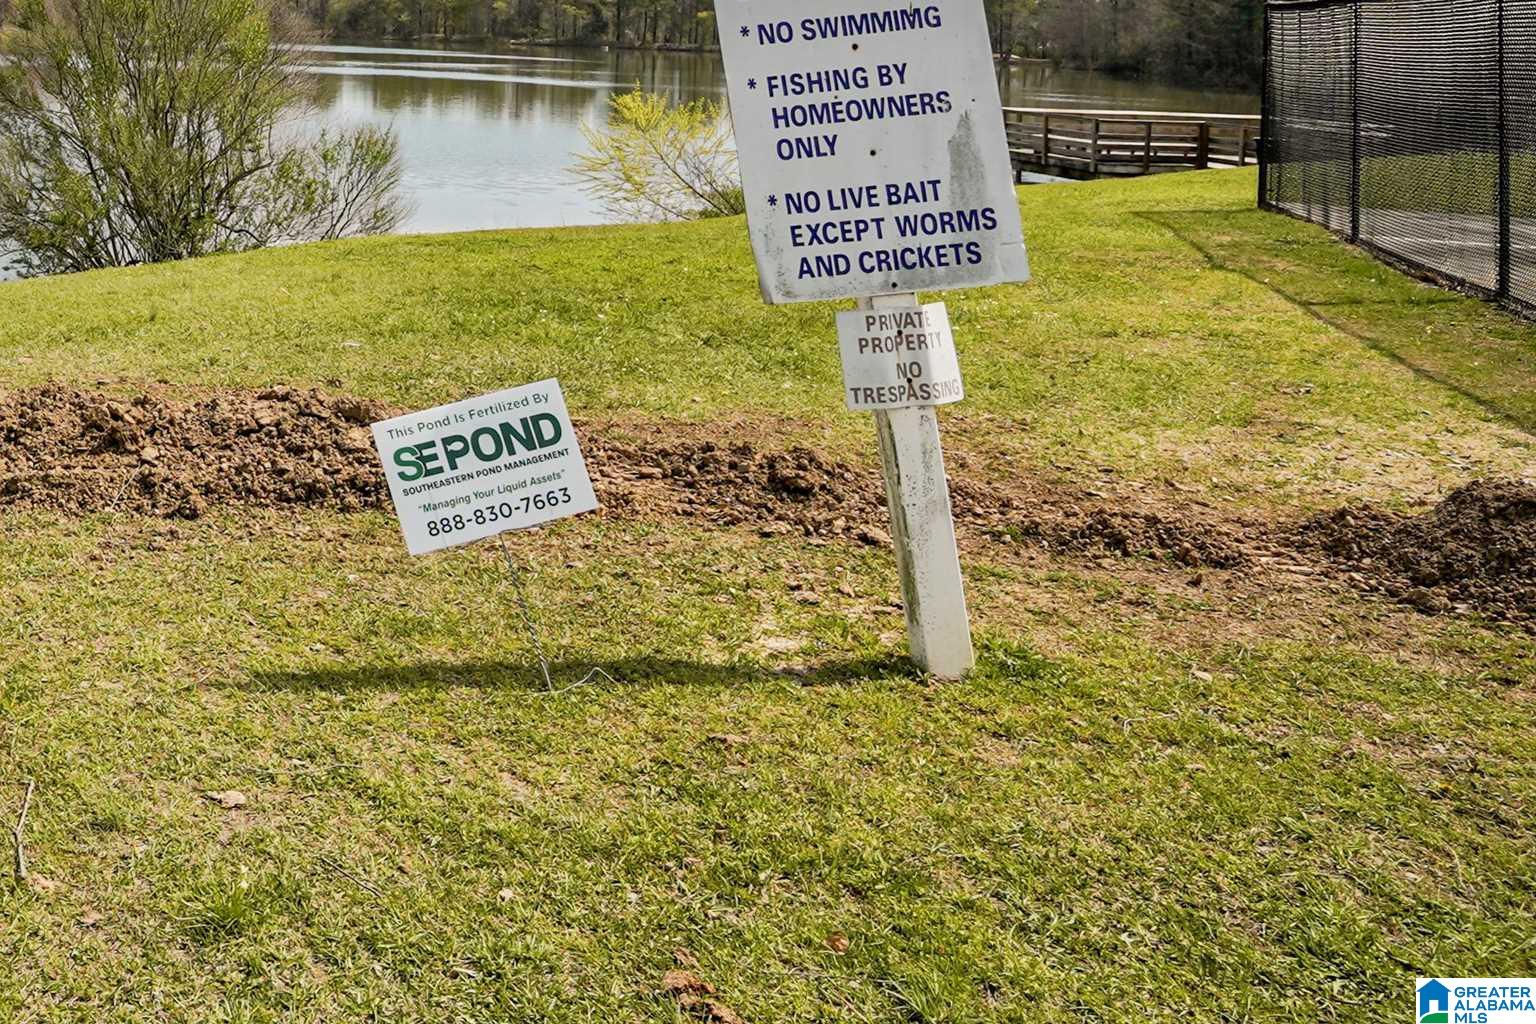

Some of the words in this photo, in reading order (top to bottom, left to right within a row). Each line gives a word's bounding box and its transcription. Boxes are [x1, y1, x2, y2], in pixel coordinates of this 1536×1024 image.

[757, 18, 794, 45] NO
[767, 67, 869, 97] FISHING
[878, 63, 908, 87] BY
[772, 91, 952, 129] HOMEOWNERS
[776, 134, 838, 161] ONLY
[784, 189, 821, 215] NO
[827, 185, 879, 210] LIVE
[885, 180, 941, 205] BAIT
[790, 217, 885, 247] EXCEPT
[895, 207, 997, 238] WORMS
[797, 253, 851, 279] AND
[859, 241, 982, 273] CRICKETS
[858, 331, 942, 354] PROPERTY
[896, 361, 922, 379] NO
[387, 426, 415, 440] This
[416, 416, 451, 432] Pond
[454, 413, 465, 423] Is
[468, 397, 529, 420] Fertilized
[533, 392, 549, 404] By
[402, 472, 474, 496] SOUTHEASTERN
[475, 465, 503, 478] POND
[504, 448, 570, 471] MANAGEMENT
[472, 488, 495, 499] Your
[497, 478, 527, 494] Liquid
[427, 487, 571, 536] 888-830-7663
